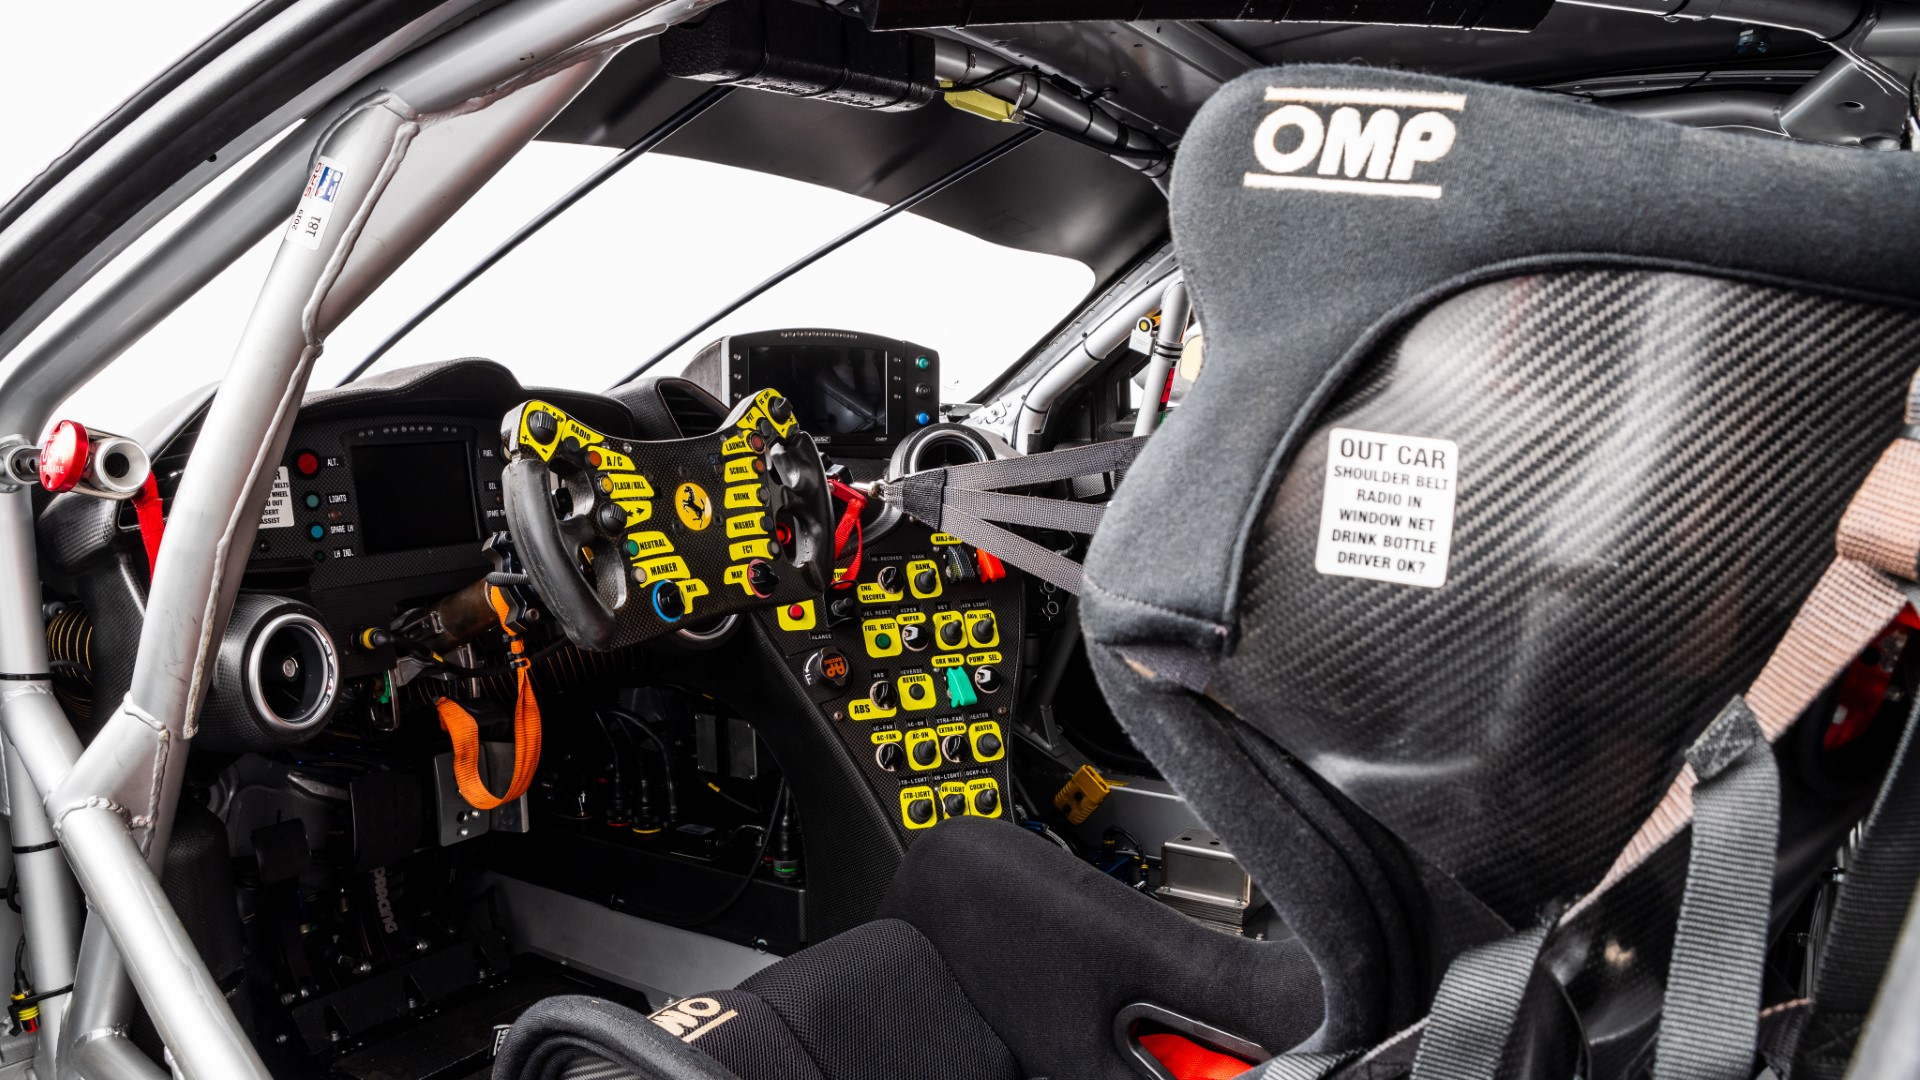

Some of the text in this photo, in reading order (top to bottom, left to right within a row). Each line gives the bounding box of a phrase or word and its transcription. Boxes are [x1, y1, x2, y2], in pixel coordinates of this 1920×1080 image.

[1254, 104, 1456, 180] OMP
[292, 209, 304, 230] 2019
[306, 216, 322, 238] 181
[746, 412, 754, 423] PIT
[570, 424, 591, 441] RADIO
[726, 441, 746, 451] LAUNCH
[1340, 438, 1446, 470] OUT CAR
[327, 458, 339, 466] ALT.
[606, 456, 623, 467] A/C
[729, 466, 748, 474] SCROLL
[1334, 465, 1448, 490] SHOULDER BELT
[328, 494, 347, 503] LIGHTS
[733, 492, 750, 501] DRINK
[1357, 488, 1422, 509] RADIO IN
[733, 520, 755, 530] WASHER
[1338, 508, 1435, 532] WINDOW NET
[330, 525, 345, 534] SPARE
[640, 539, 666, 550] NEUTRAL
[1332, 528, 1437, 554] DRINK BOTTLE
[742, 545, 753, 554] FCY
[1338, 551, 1426, 574] DRIVER OK?
[650, 562, 678, 576] MARKER
[731, 570, 742, 579] MAP
[686, 584, 697, 592] MIX
[902, 675, 926, 683] REVERSE
[854, 704, 870, 714] ABS
[939, 725, 964, 733] EXTRA-FAN
[877, 733, 896, 741] AC-FAN
